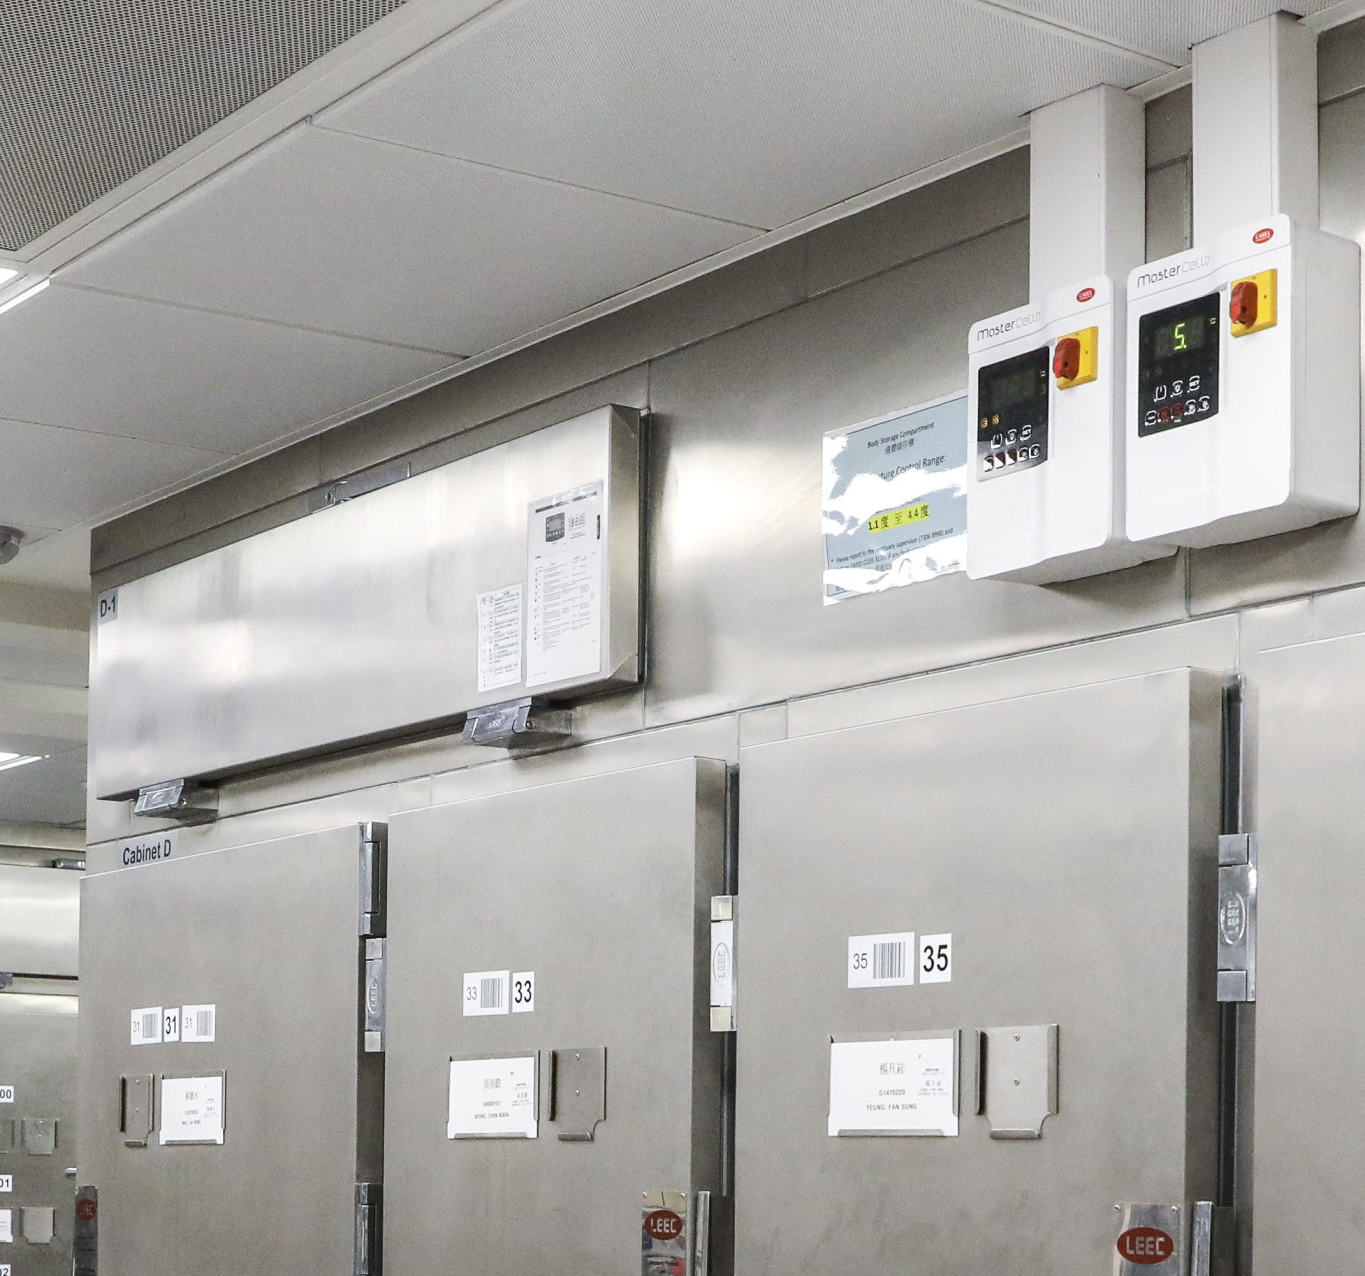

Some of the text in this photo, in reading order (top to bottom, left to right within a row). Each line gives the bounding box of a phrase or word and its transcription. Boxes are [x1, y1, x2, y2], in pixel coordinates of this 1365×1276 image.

[867, 422, 935, 449] Body Storage Compartment
[868, 520, 880, 531] 1.1
[99, 595, 117, 618] D-1
[123, 839, 172, 866] Cabinet D
[853, 952, 868, 970] 35
[922, 943, 950, 974] 35
[466, 986, 478, 1001] 33
[513, 978, 533, 1005] 33
[165, 1015, 177, 1035] 31
[184, 1016, 193, 1029] 31
[650, 1218, 677, 1233] LEEC
[1125, 1235, 1165, 1256] LEEC
